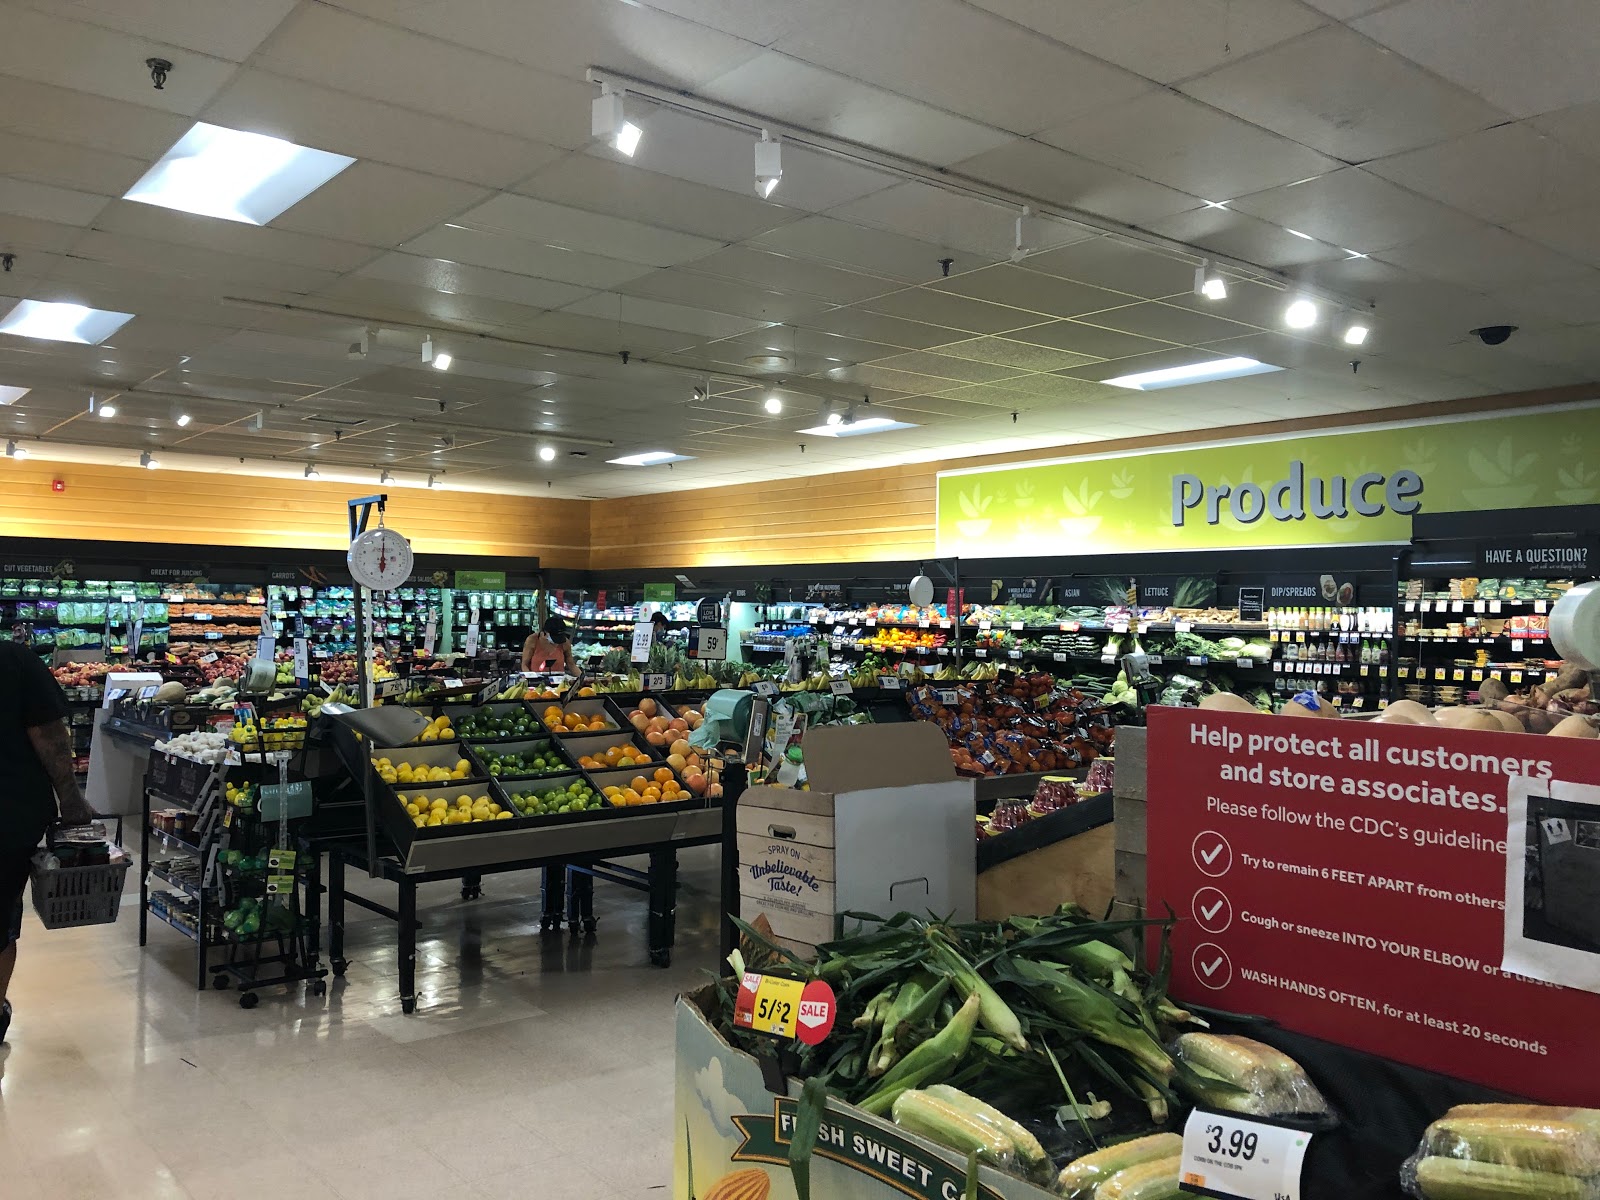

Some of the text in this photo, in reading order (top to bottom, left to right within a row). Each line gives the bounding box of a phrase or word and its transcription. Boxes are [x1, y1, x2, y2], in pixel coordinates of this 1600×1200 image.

[1171, 460, 1424, 527] Produce
[4, 564, 16, 572] CUT
[1485, 548, 1588, 563] HAVE A QUESTION?
[150, 568, 168, 576] GREAT
[272, 572, 296, 580] CARROTS
[1064, 588, 1080, 598] ASIAN
[1144, 587, 1169, 597] LETTUCE
[1271, 586, 1317, 597] DIP/SPREADS
[1190, 723, 1553, 779] Help protect all customers
[1220, 762, 1507, 814] and store associates.
[1206, 796, 1258, 818] Please
[1261, 804, 1312, 826] follow
[1315, 812, 1346, 831] the
[1350, 815, 1409, 840] CDC's
[767, 845, 800, 860] SPRAY ON
[750, 859, 820, 893] Unbelievable
[767, 875, 802, 897] Taste!
[1241, 853, 1505, 910] Try to remain 6 FEET APART from others
[1241, 910, 1279, 930] Cough
[1281, 921, 1294, 932] or
[1296, 924, 1340, 942] sneeze
[1342, 932, 1376, 950] INTO
[1380, 939, 1421, 960] YOUR
[1424, 950, 1480, 972] ELBOW
[1482, 964, 1500, 976] or
[758, 998, 791, 1024] 5/$2
[800, 1005, 826, 1018] SALE
[1240, 967, 1548, 1056] WASH HANDS OFTEN, for at least 20 seconds
[780, 1114, 933, 1188] FSH SWEET
[1206, 1124, 1258, 1161] $3.99
